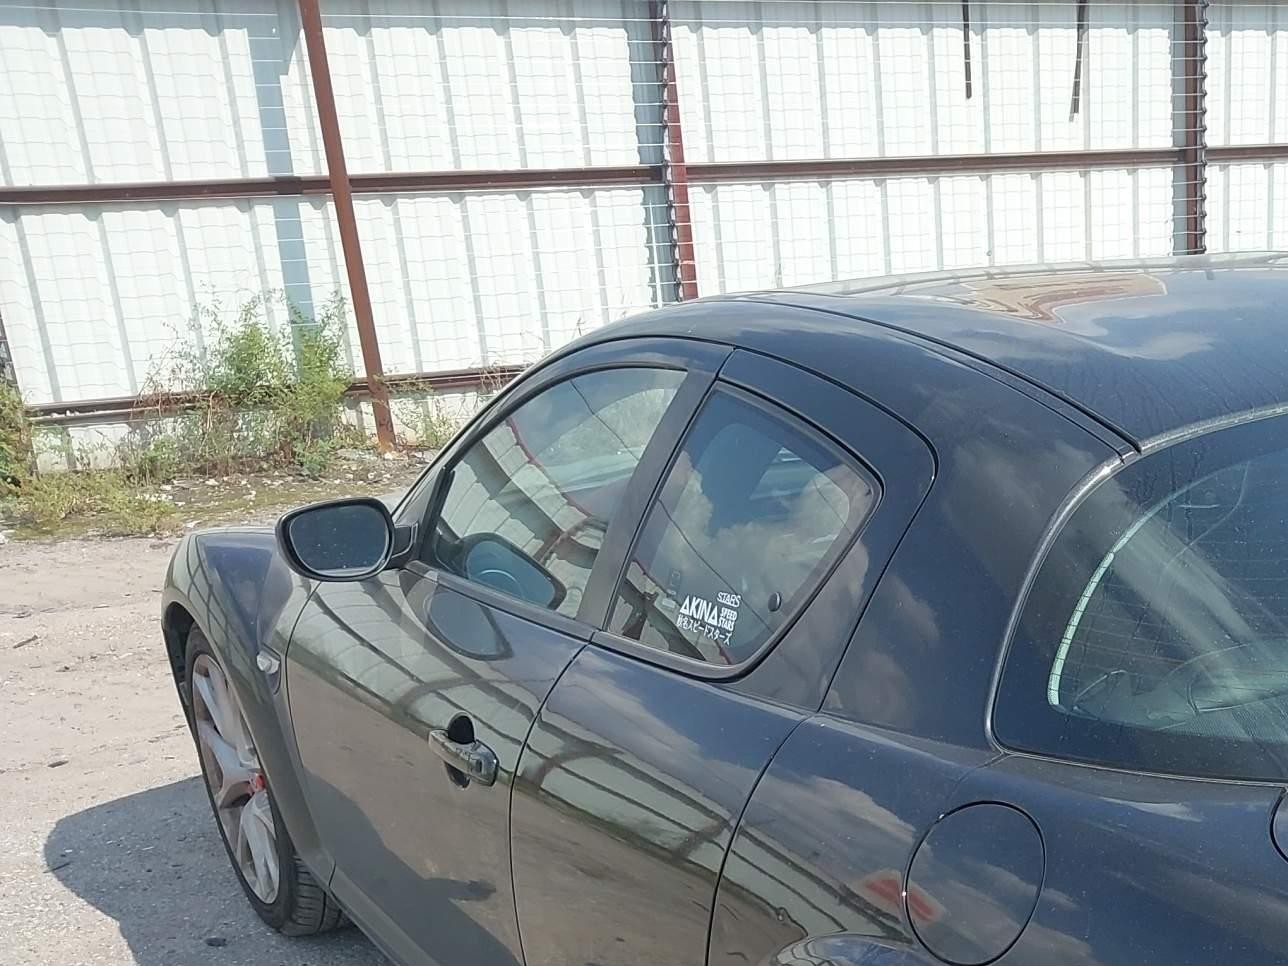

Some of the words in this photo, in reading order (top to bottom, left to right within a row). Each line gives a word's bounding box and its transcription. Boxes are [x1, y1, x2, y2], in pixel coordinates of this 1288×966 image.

[679, 595, 719, 626] AKINA
[720, 606, 738, 622] SPEED
[718, 616, 735, 632] STARS
